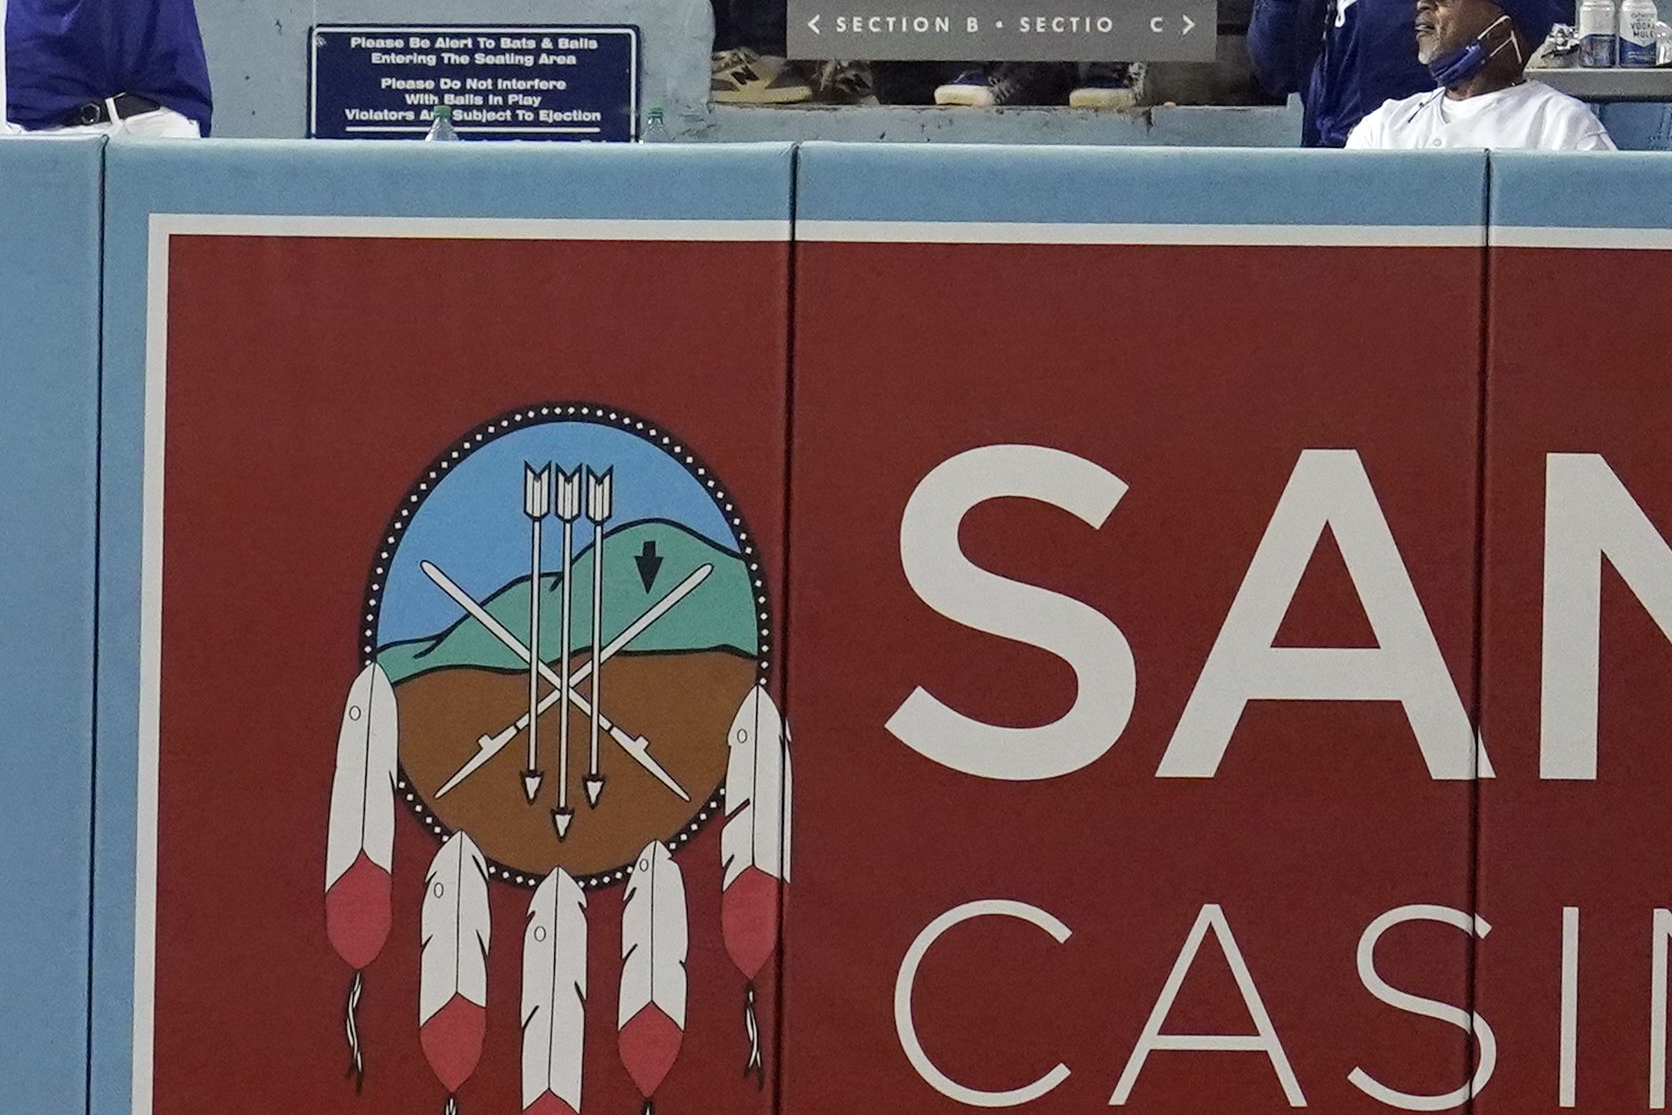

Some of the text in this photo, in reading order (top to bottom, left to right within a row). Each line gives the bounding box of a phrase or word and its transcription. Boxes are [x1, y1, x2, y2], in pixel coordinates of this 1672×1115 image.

[835, 16, 1163, 33] SECTION B SECTIO C
[350, 37, 598, 50] Please Be Alert To Bats & Balls
[371, 52, 576, 66] Entering The Seating Area
[381, 77, 567, 90] Please Do Not Interfere
[405, 93, 542, 106] With Balls In Play
[344, 108, 601, 122] Violators Ar Subject To Ejection
[884, 443, 1672, 782] SAN
